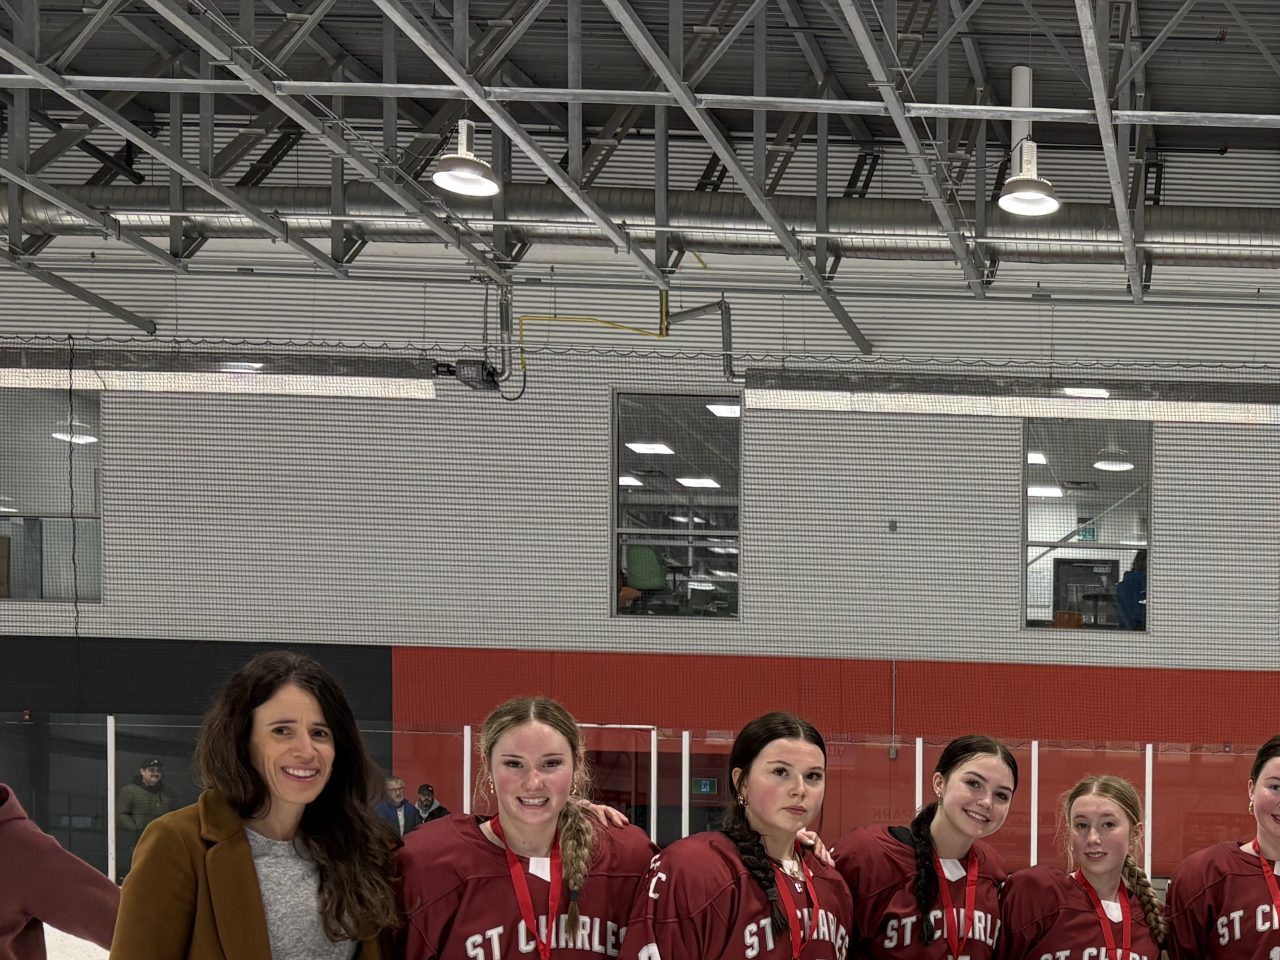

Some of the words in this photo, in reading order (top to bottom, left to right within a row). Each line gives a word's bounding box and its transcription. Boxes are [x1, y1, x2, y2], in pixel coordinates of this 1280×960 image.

[744, 918, 774, 959] ST
[884, 915, 917, 949] ST
[1217, 909, 1244, 946] ST
